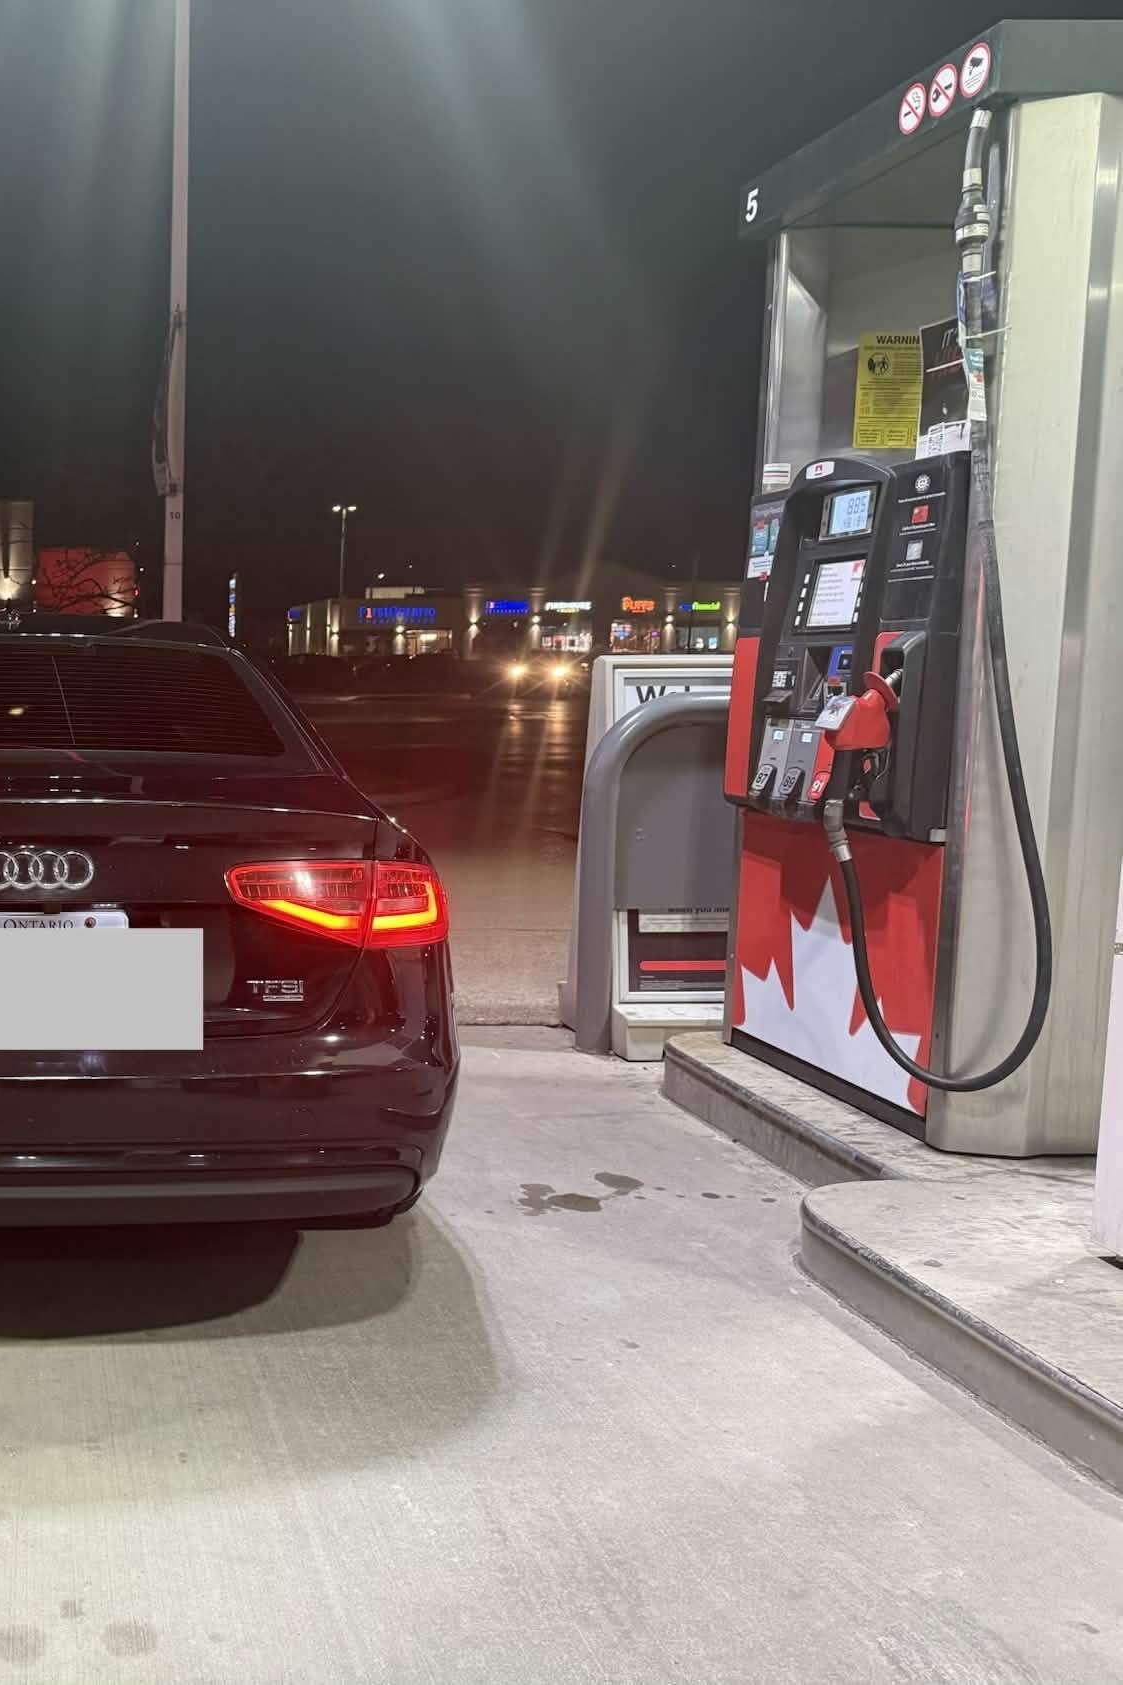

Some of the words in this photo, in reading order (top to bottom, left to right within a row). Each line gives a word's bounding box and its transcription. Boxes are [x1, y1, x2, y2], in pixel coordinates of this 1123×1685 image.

[745, 187, 759, 222] 5
[876, 335, 921, 345] WARNIN
[3, 919, 74, 928] ONTARIO
